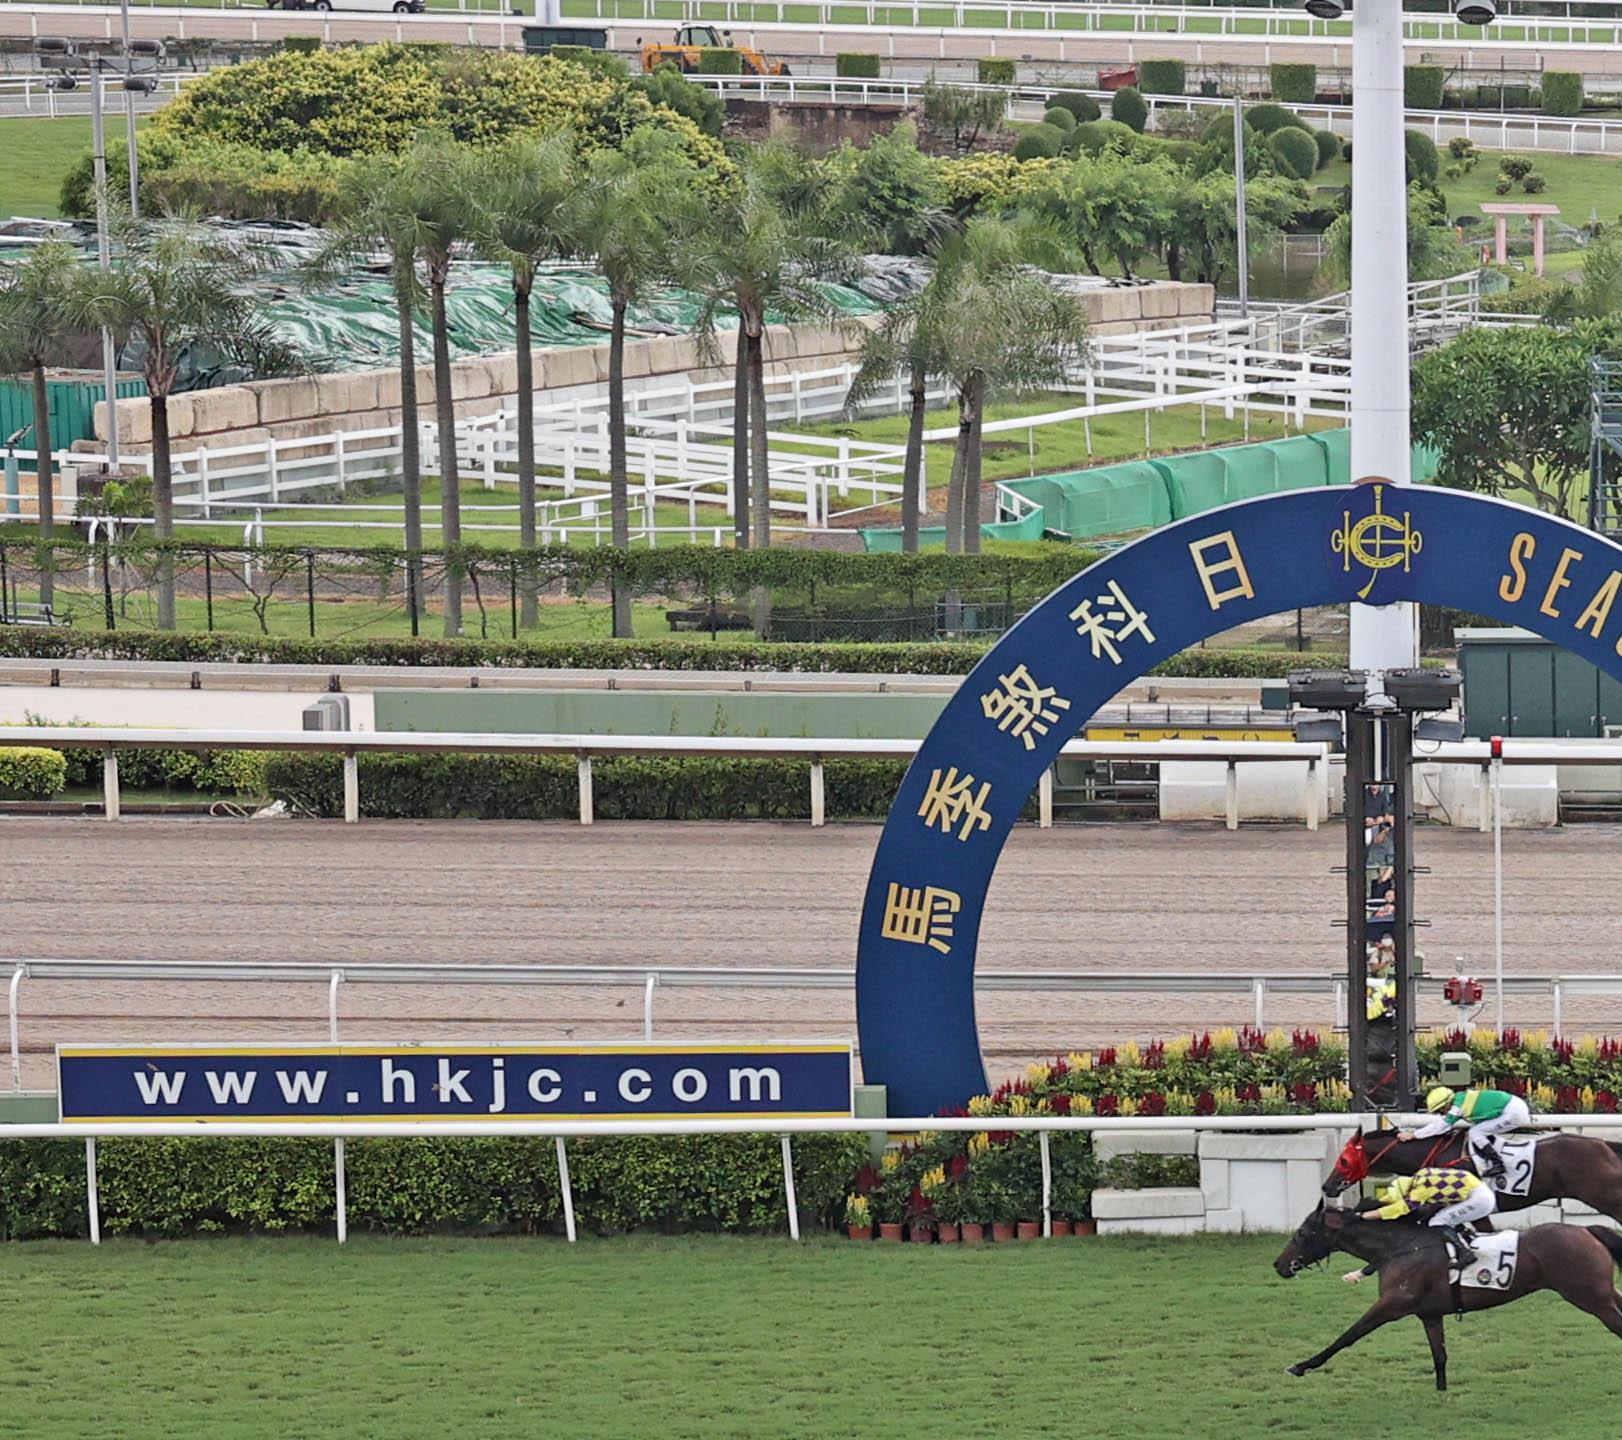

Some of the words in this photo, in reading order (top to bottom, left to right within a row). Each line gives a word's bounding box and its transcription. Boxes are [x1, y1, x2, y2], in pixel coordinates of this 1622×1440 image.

[881, 531, 1255, 954] 馬季煞科日
[134, 1057, 782, 1113] www.hkjc.com
[1511, 1159, 1532, 1193] 2
[1496, 1251, 1515, 1288] 5
